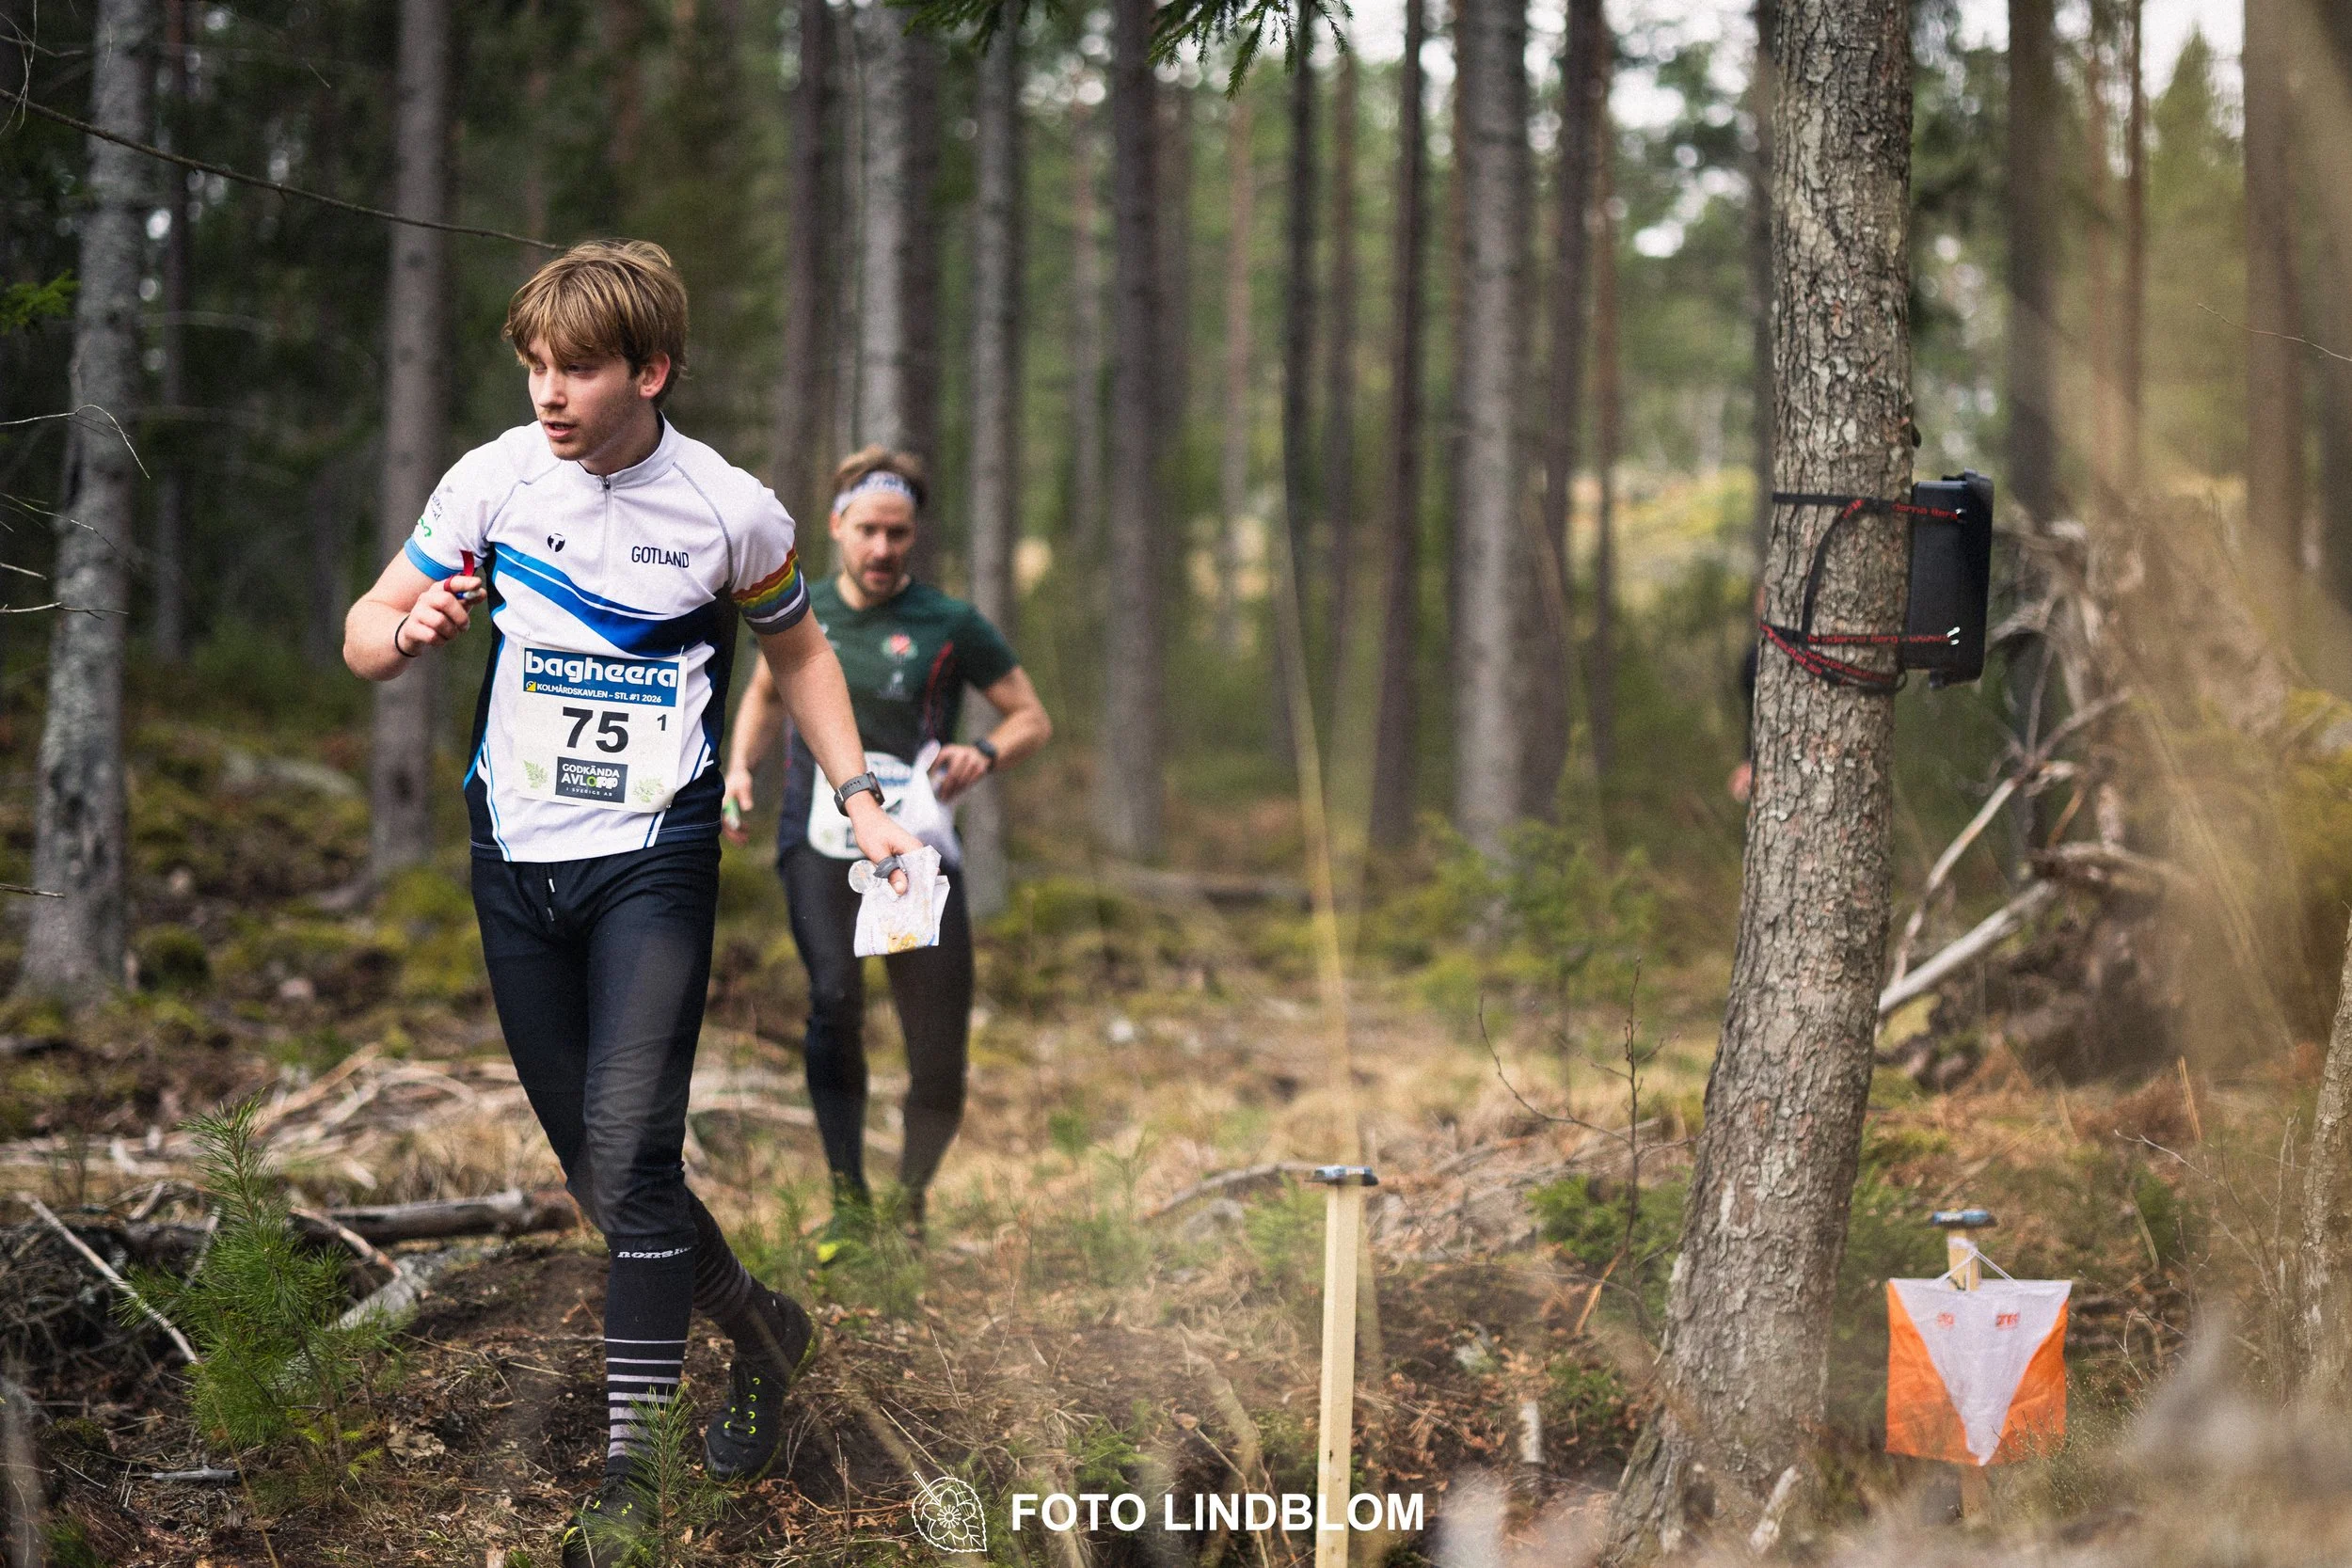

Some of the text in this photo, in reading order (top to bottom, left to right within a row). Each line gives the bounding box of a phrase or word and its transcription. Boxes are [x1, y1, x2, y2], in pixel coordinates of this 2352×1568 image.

[631, 546, 690, 569] GOTLAND
[525, 651, 678, 688] bagheera
[537, 683, 608, 698] KOLMÅRDSKAVLEN
[614, 692, 628, 701] STL
[629, 693, 641, 702] #1
[642, 694, 662, 703] 2026
[563, 706, 629, 753] 75
[657, 714, 667, 731] 1
[562, 763, 620, 778] GODKÄNDA
